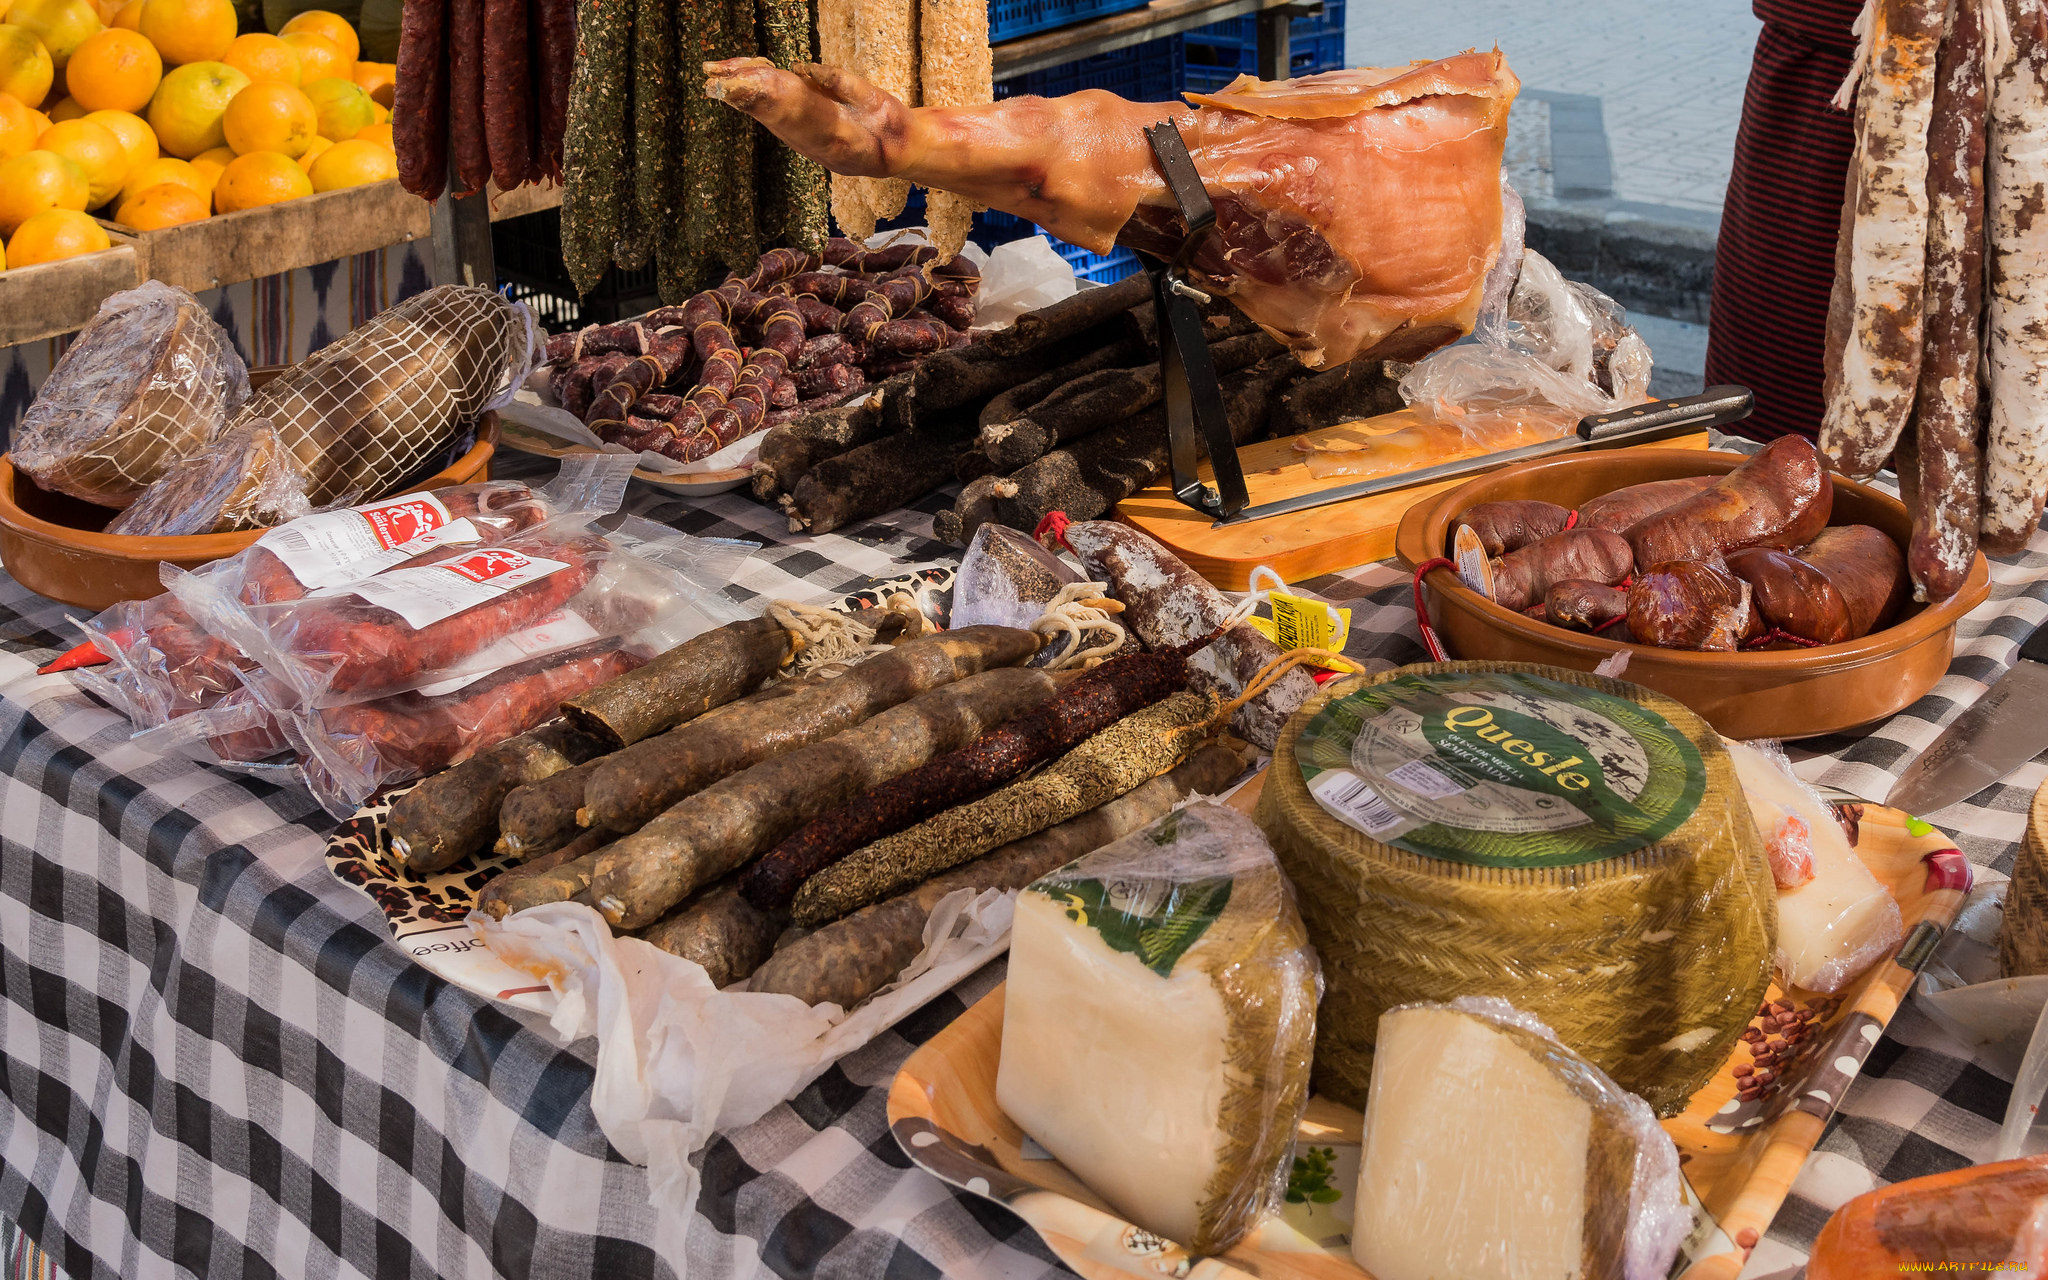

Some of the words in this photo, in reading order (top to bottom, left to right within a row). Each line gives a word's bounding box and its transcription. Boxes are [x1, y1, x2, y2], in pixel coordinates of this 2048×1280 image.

[369, 511, 397, 549] Sanfermin
[1436, 738, 1511, 782] SEMICURADO
[1444, 706, 1590, 791] Quesle
[1448, 733, 1477, 751] QUESO
[1490, 754, 1525, 779] MEZCLA
[412, 938, 487, 956] offee
